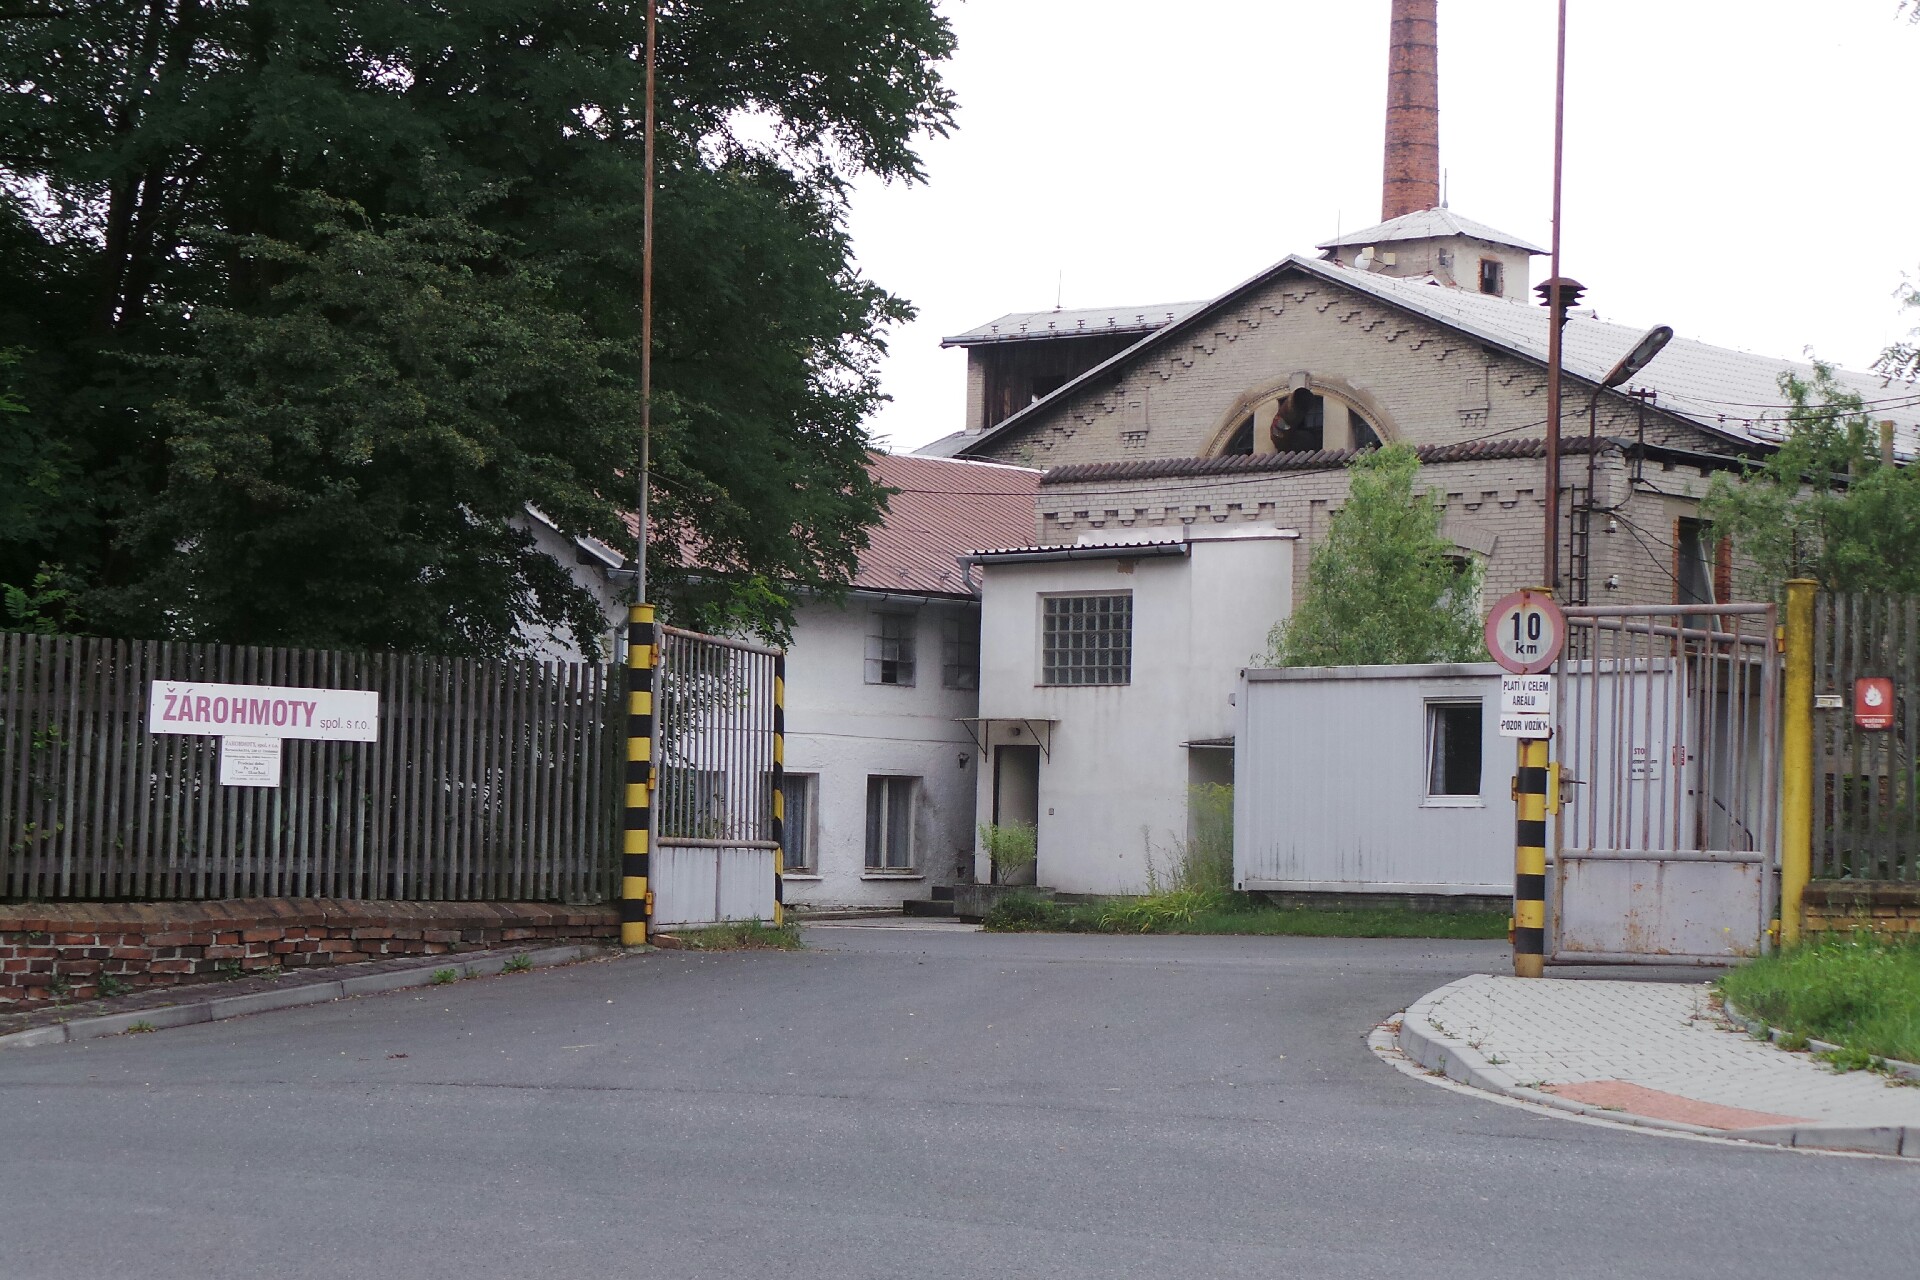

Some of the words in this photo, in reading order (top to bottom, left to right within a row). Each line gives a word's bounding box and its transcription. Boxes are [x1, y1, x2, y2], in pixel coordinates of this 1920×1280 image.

[1511, 612, 1541, 640] 10
[1515, 641, 1537, 655] km
[1522, 680, 1527, 691] V
[163, 688, 317, 727] ŽÁROHMOTY
[320, 717, 344, 731] spol.
[346, 720, 352, 729] s
[1501, 720, 1522, 731] POZOR
